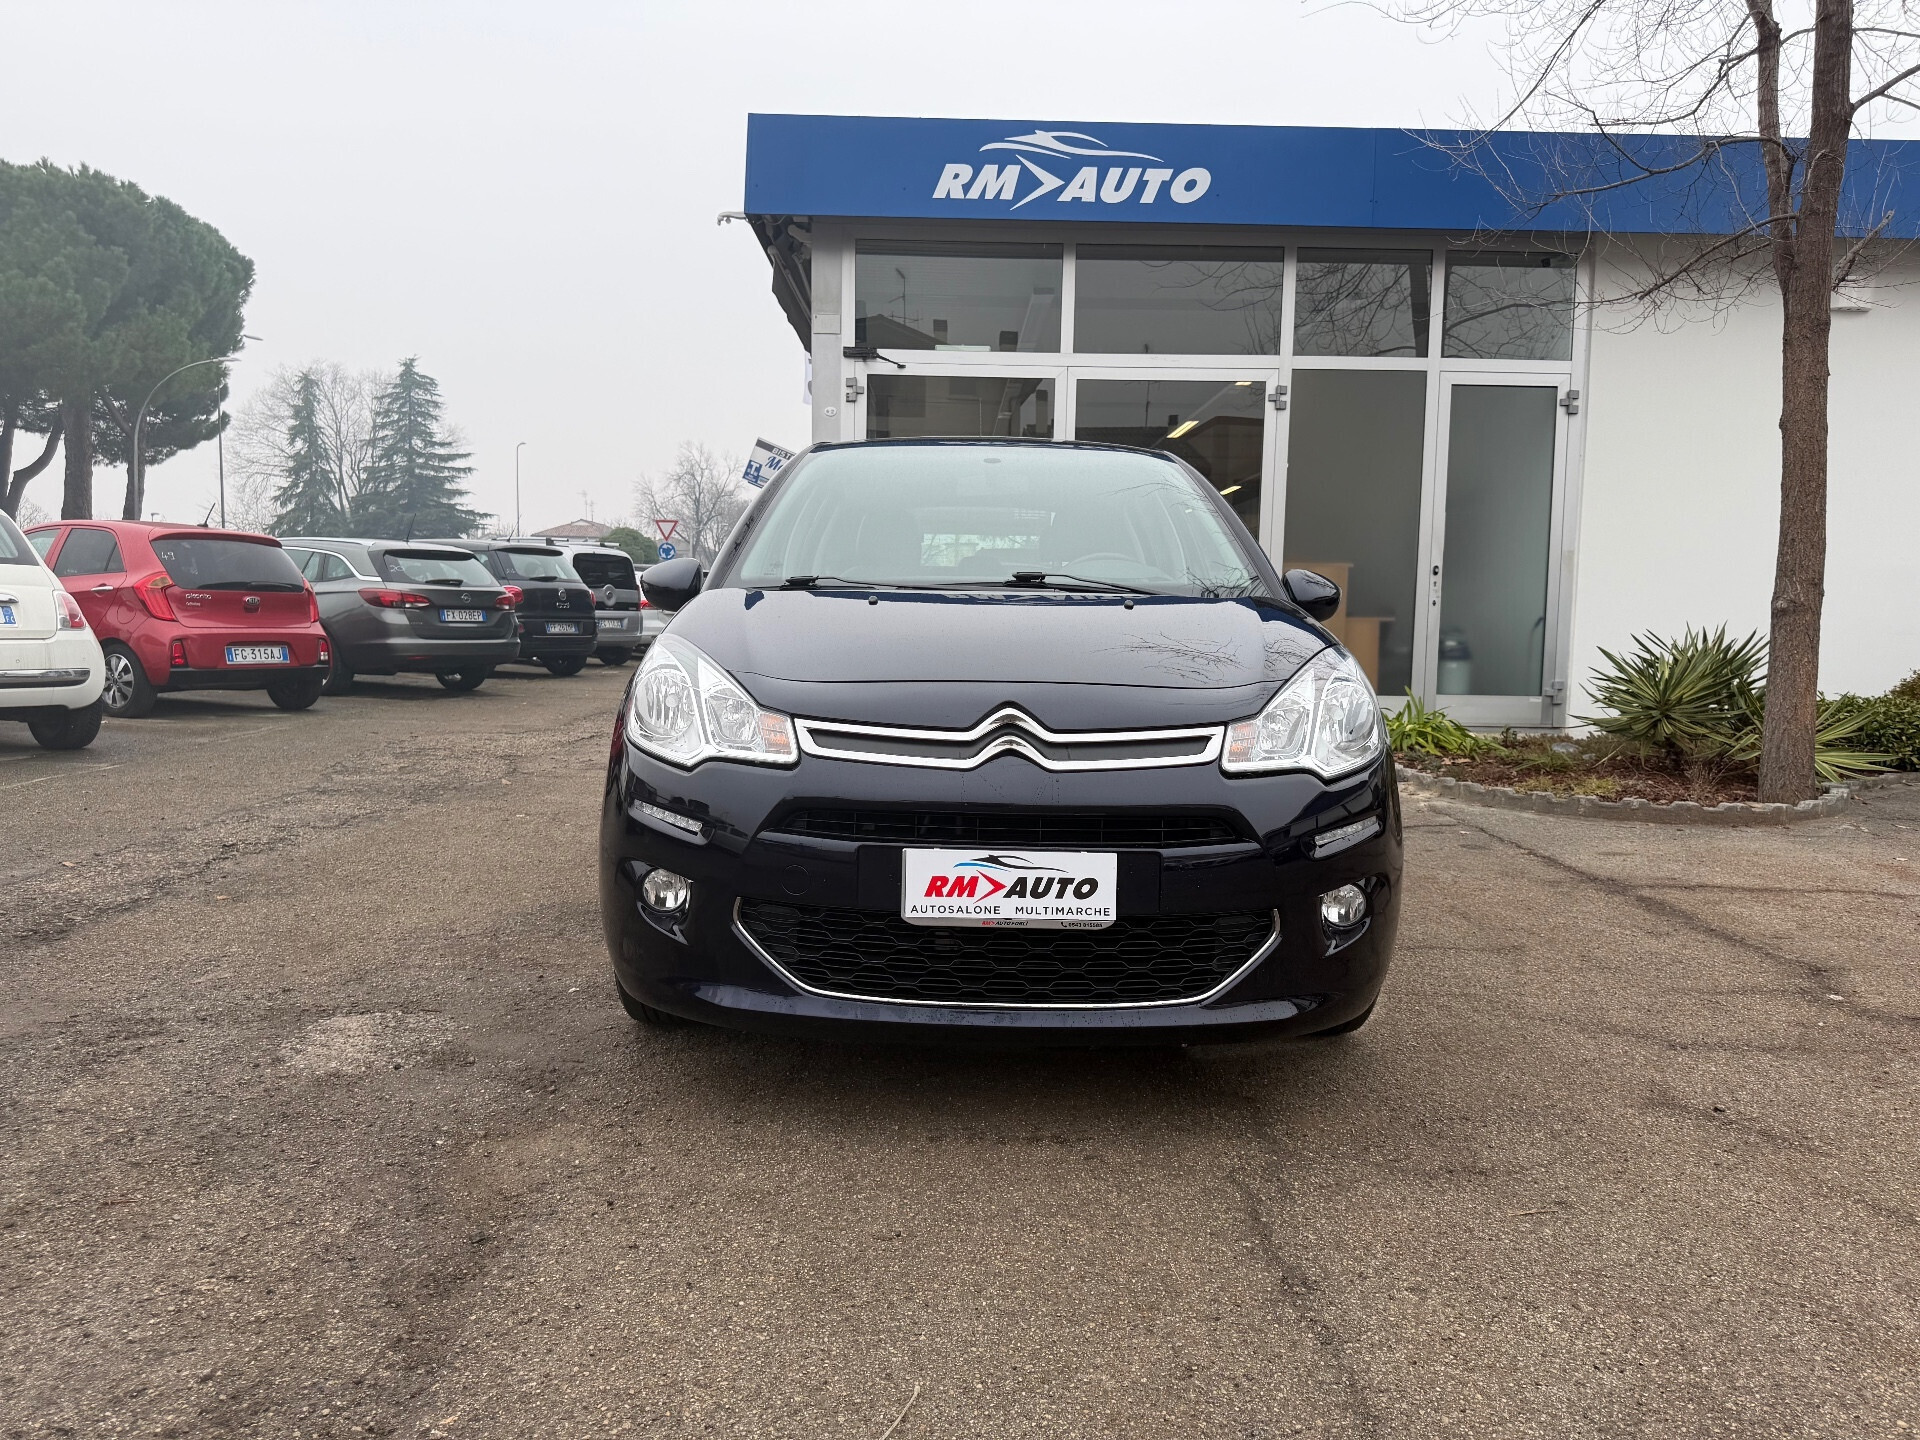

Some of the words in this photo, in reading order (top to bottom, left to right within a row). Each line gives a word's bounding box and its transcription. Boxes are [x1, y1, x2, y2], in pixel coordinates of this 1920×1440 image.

[1056, 167, 1212, 204] AUTO
[1003, 877, 1099, 900] AUTO
[910, 904, 1001, 915] AUTOSALONE
[1015, 906, 1111, 917] MULTIMARCHE
